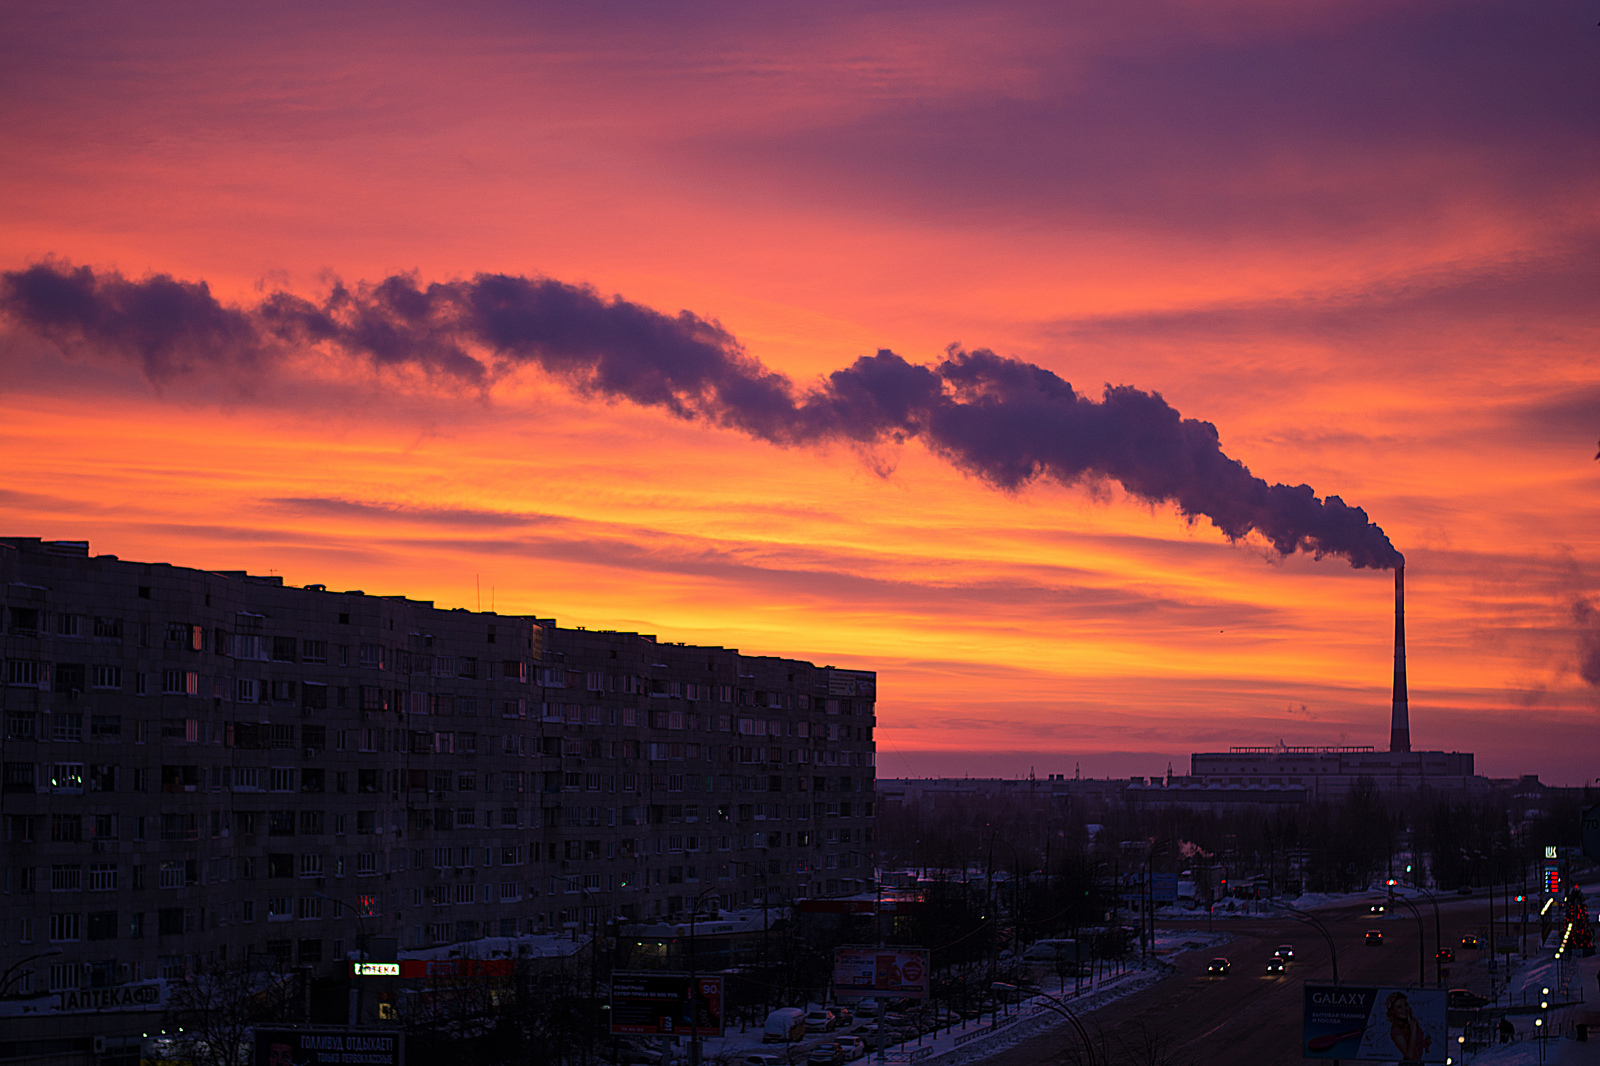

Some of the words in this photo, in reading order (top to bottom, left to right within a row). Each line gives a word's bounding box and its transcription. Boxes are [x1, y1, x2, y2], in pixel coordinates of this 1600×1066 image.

[702, 984, 717, 994] 90
[67, 988, 133, 1009] АПТЕКА
[1312, 992, 1366, 1005] GALAXY
[300, 1035, 344, 1051] ГОЛЛИВУД
[345, 1037, 393, 1051] ОТДЫХАЕТ!
